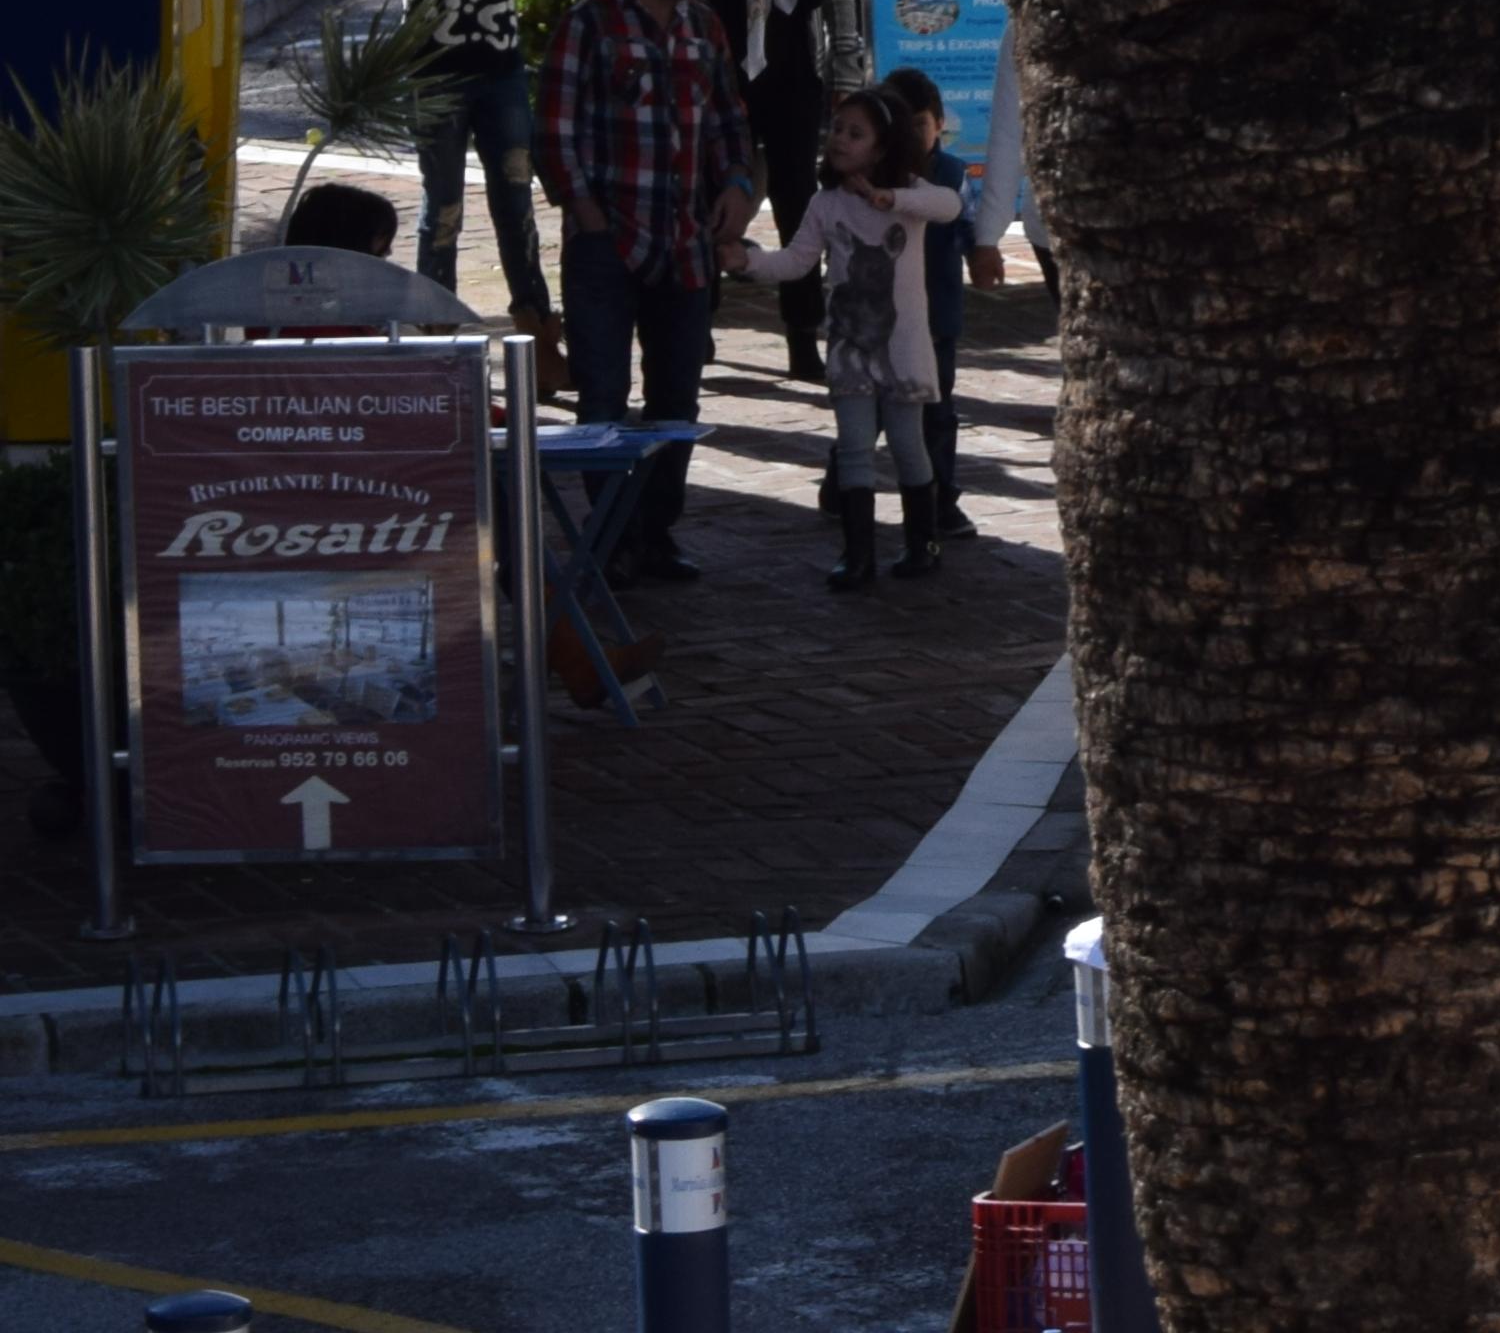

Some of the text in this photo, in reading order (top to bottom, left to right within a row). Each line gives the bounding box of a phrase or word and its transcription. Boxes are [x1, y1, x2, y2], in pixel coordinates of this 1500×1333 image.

[897, 39, 934, 52] TRIPS
[937, 39, 945, 51] &
[151, 394, 449, 416] THE BEST ITALIAN CUISINE
[237, 426, 364, 443] COMPARE US
[188, 471, 431, 506] RISTORANTE ITALIANO
[155, 509, 454, 558] Rosatti
[243, 731, 379, 747] PANORAMIC VIEWS
[215, 750, 409, 769] Reservas 952 79 66 06
